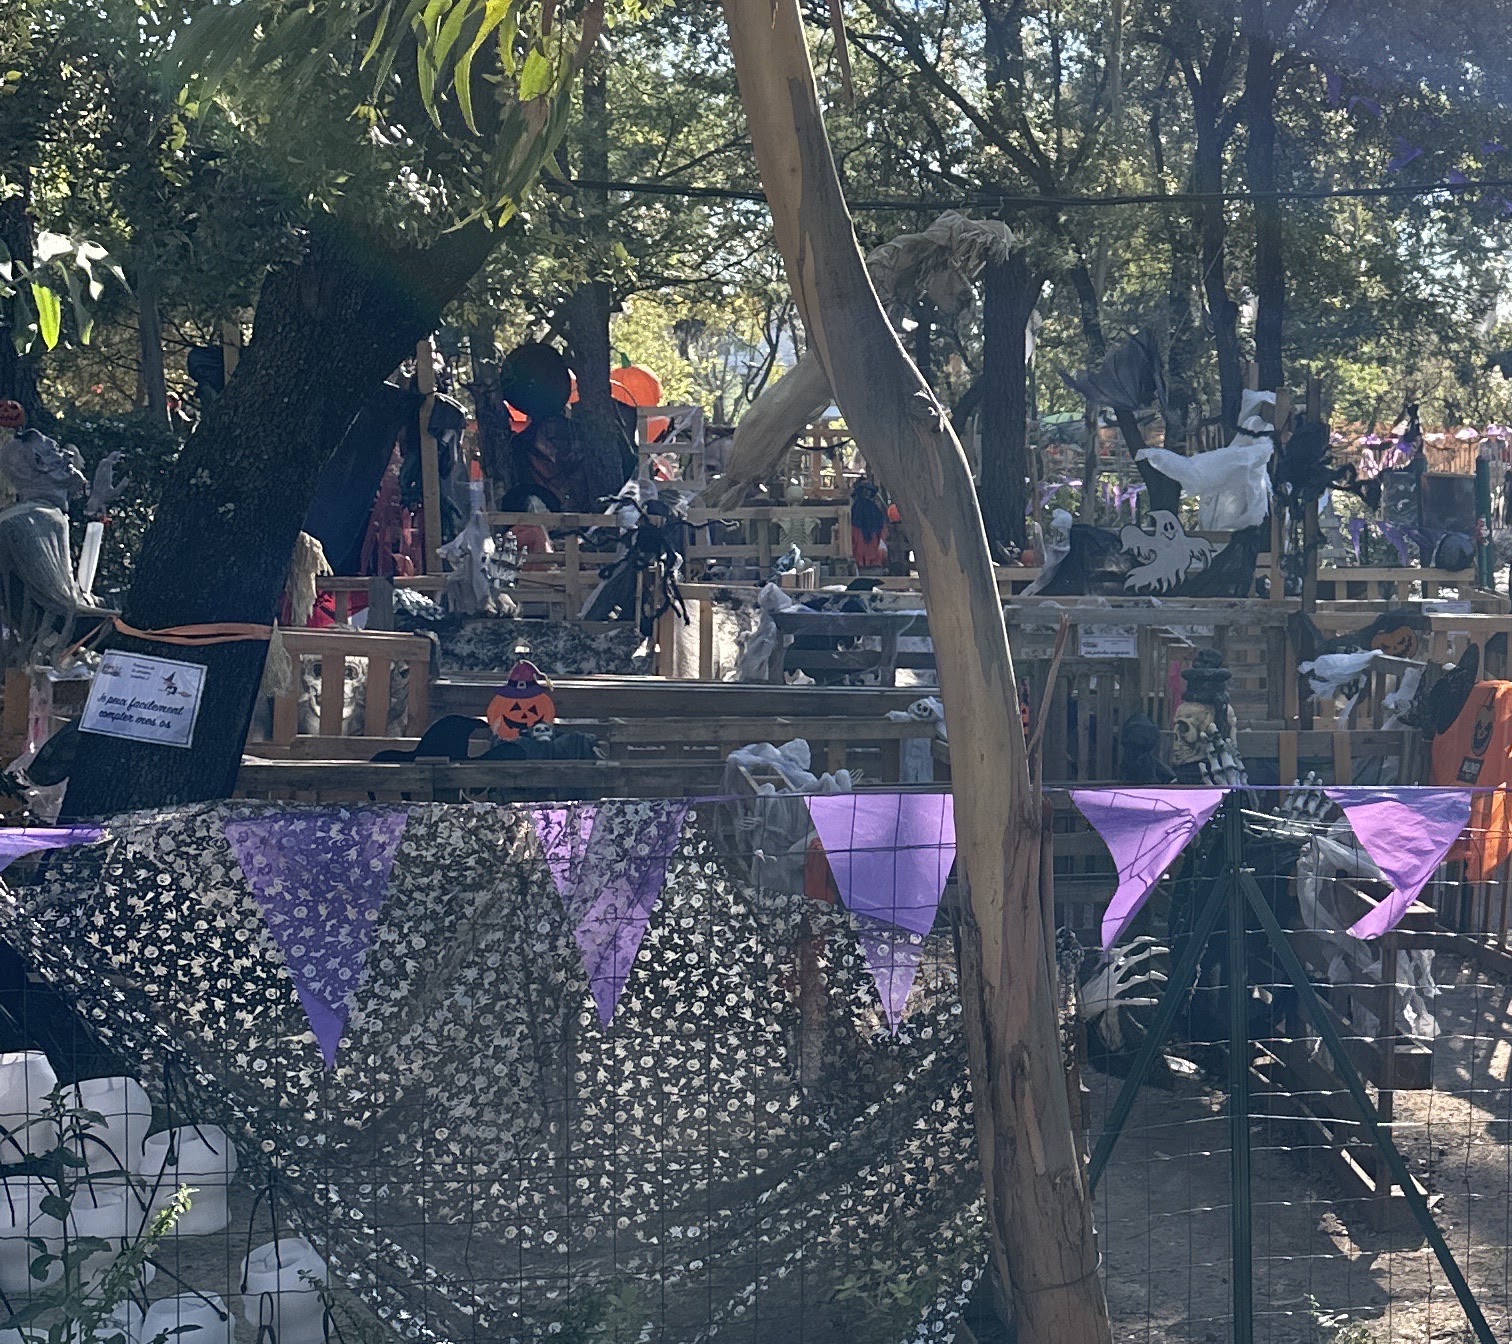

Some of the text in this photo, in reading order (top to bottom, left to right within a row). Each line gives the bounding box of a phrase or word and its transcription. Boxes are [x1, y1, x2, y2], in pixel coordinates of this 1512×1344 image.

[104, 695, 128, 707] peux
[127, 697, 184, 716] facilement
[98, 709, 172, 729] compter mes os
